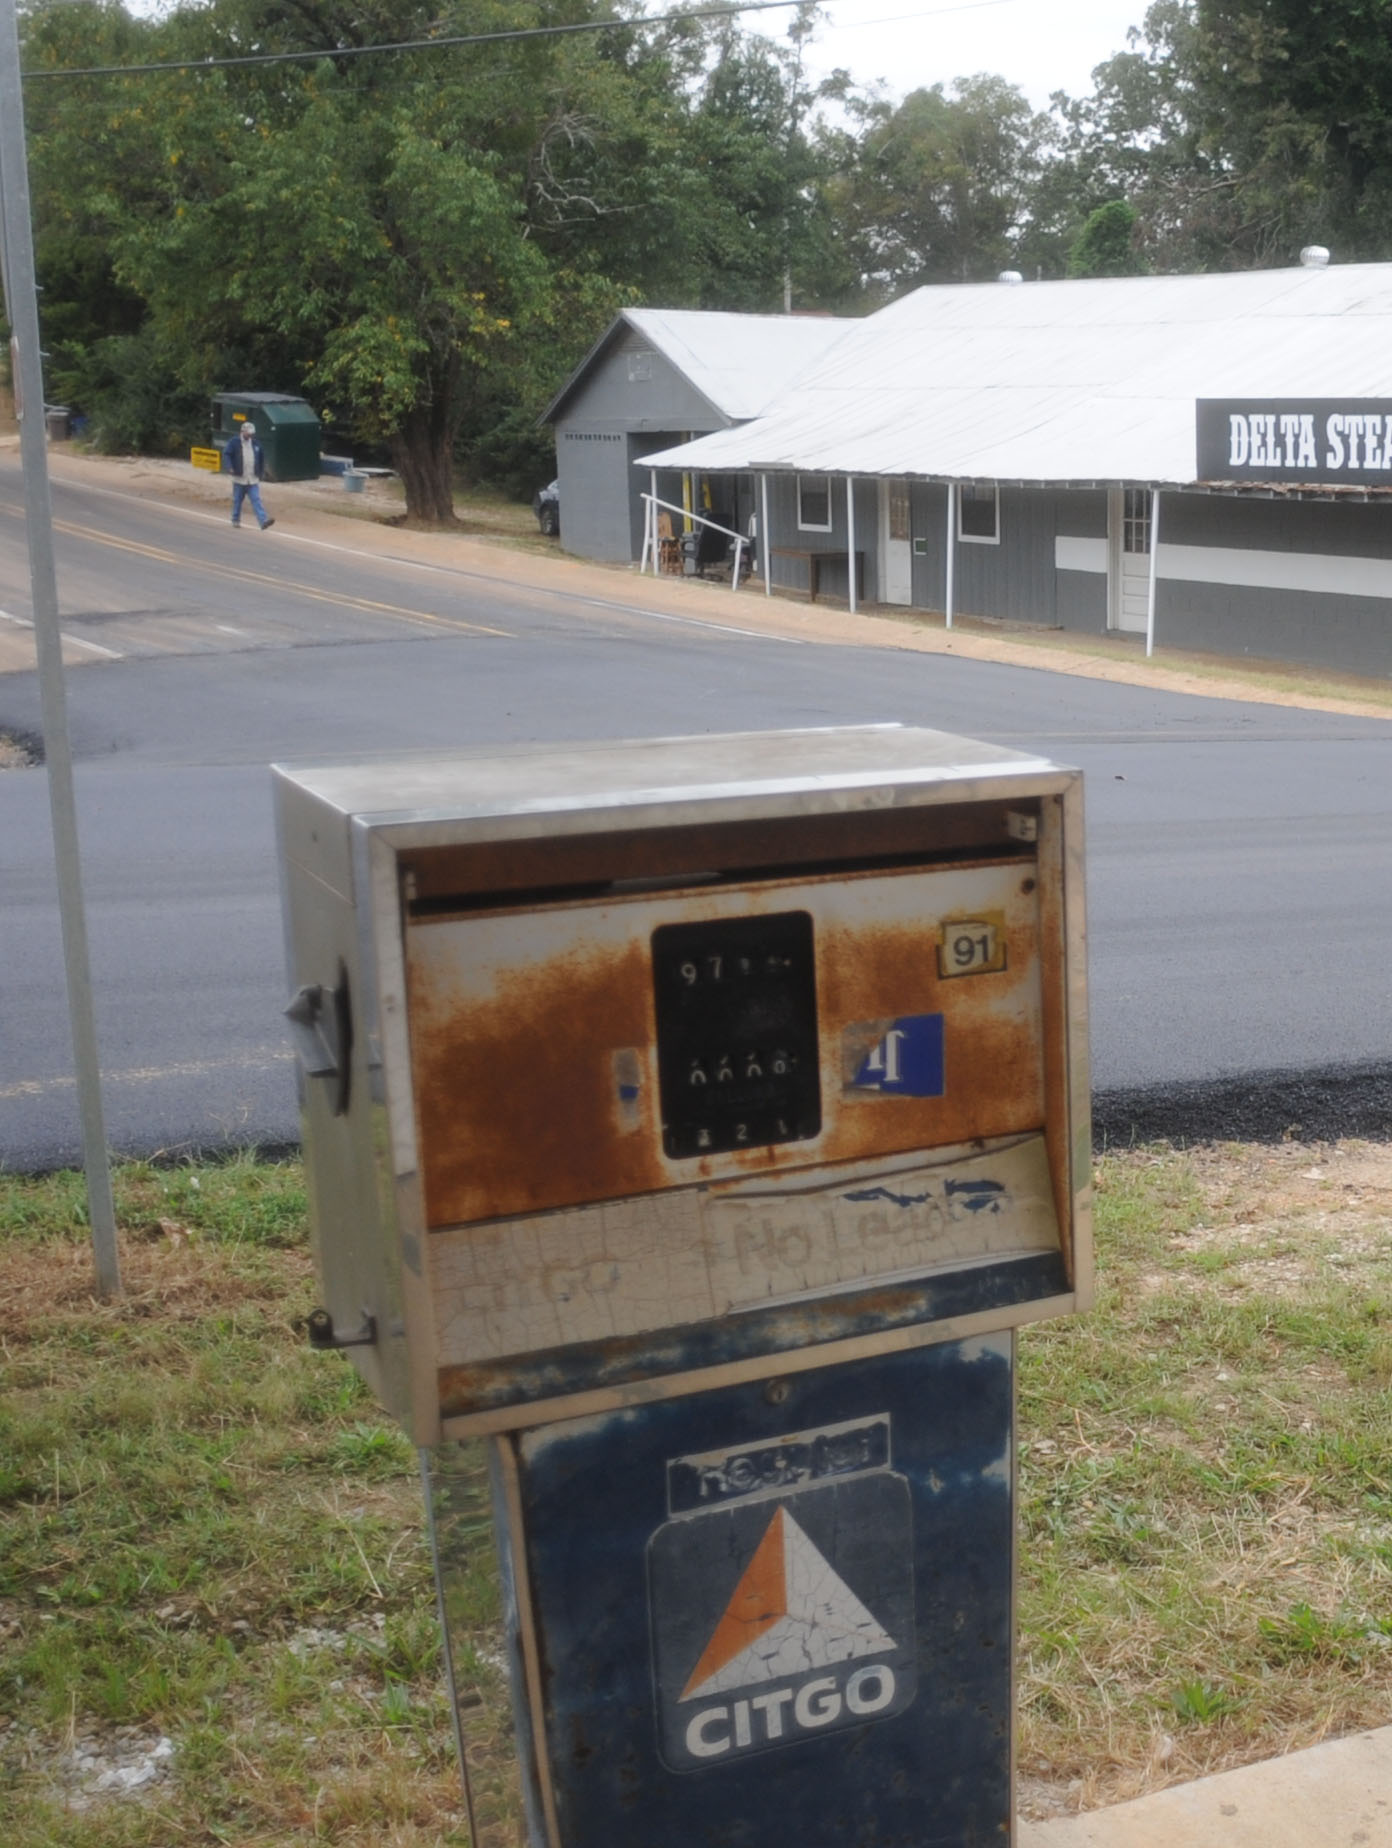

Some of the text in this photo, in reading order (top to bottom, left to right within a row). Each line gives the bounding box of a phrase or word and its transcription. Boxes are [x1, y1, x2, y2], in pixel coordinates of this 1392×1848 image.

[1229, 414, 1317, 468] DELTA
[953, 934, 990, 966] 91
[685, 1664, 896, 1758] CITGO
